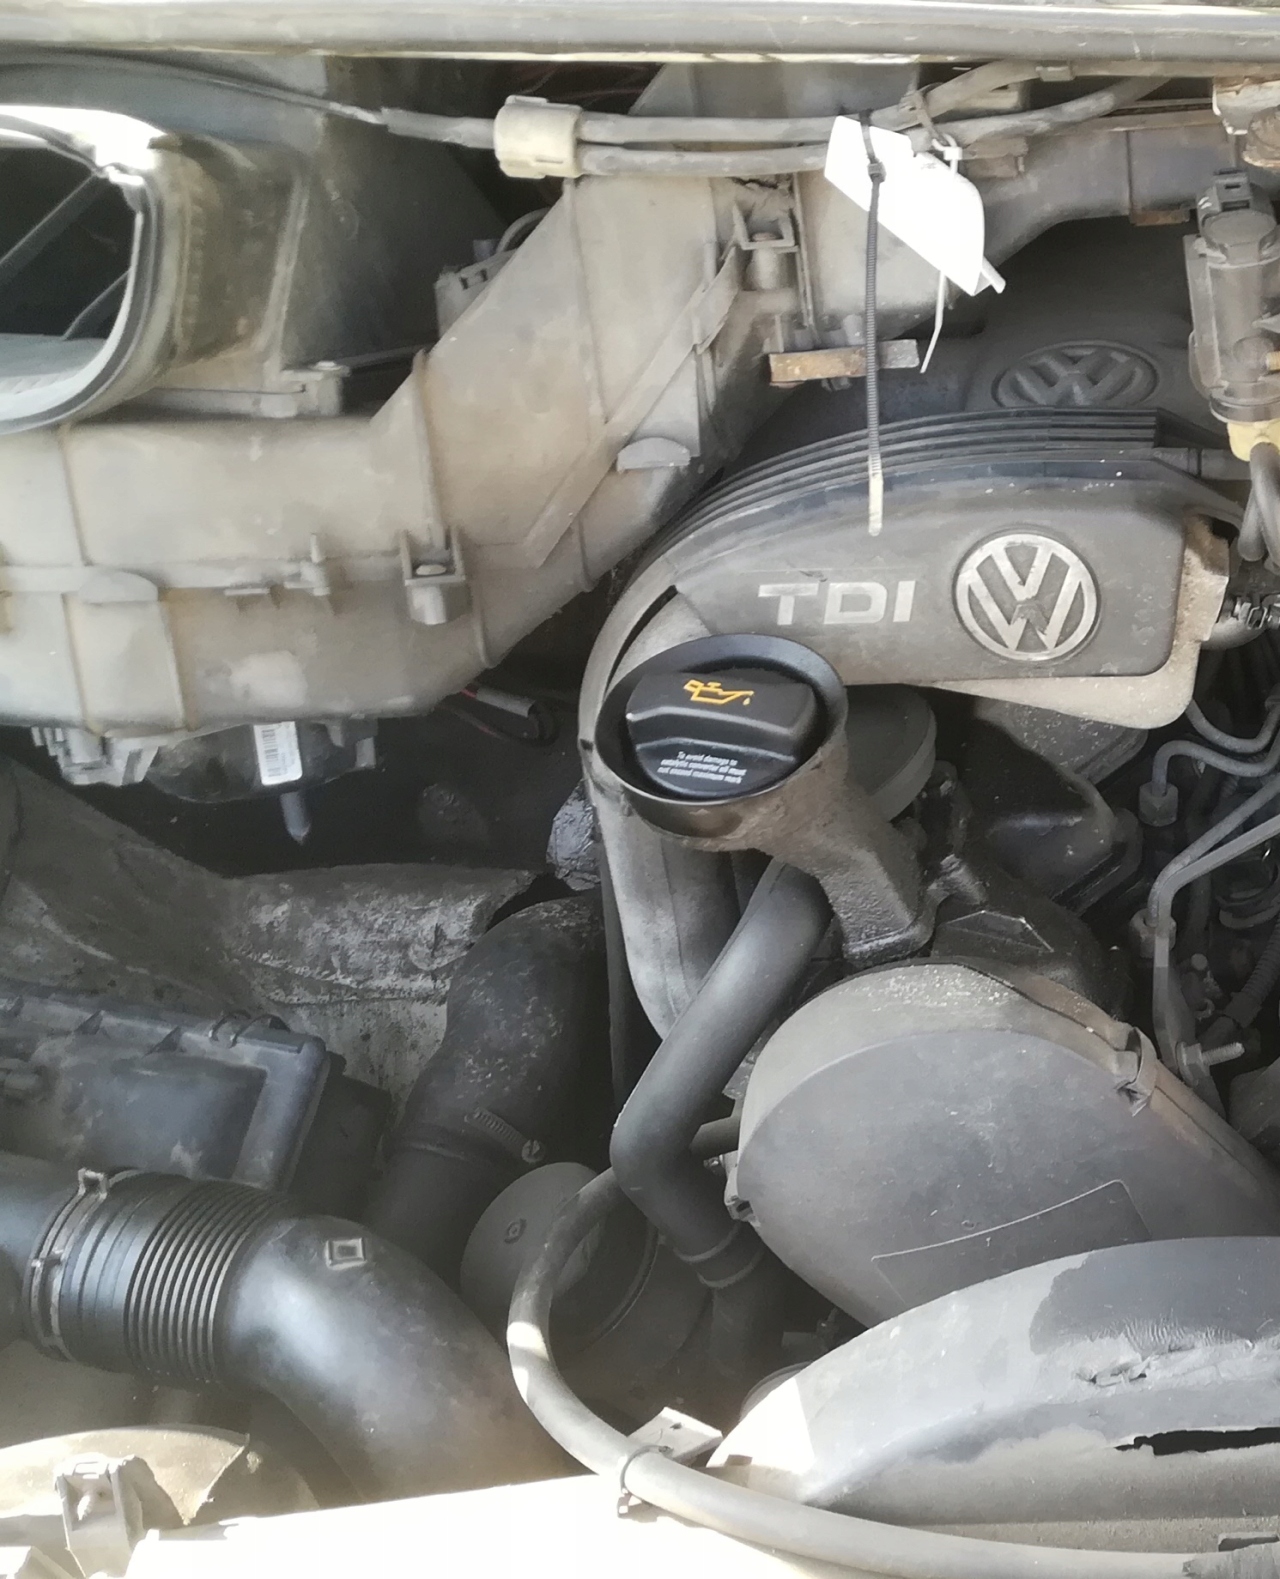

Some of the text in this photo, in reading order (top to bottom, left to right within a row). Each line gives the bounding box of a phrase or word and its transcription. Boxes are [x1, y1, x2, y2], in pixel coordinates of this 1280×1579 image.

[758, 580, 916, 626] TDI
[677, 751, 686, 760] To
[703, 755, 730, 765] damage
[728, 759, 738, 767] to
[660, 759, 689, 768] catalytic
[688, 762, 720, 773] converter
[727, 767, 748, 776] must
[669, 768, 694, 776] exceed
[692, 770, 724, 780] maximum
[724, 775, 742, 783] mark
